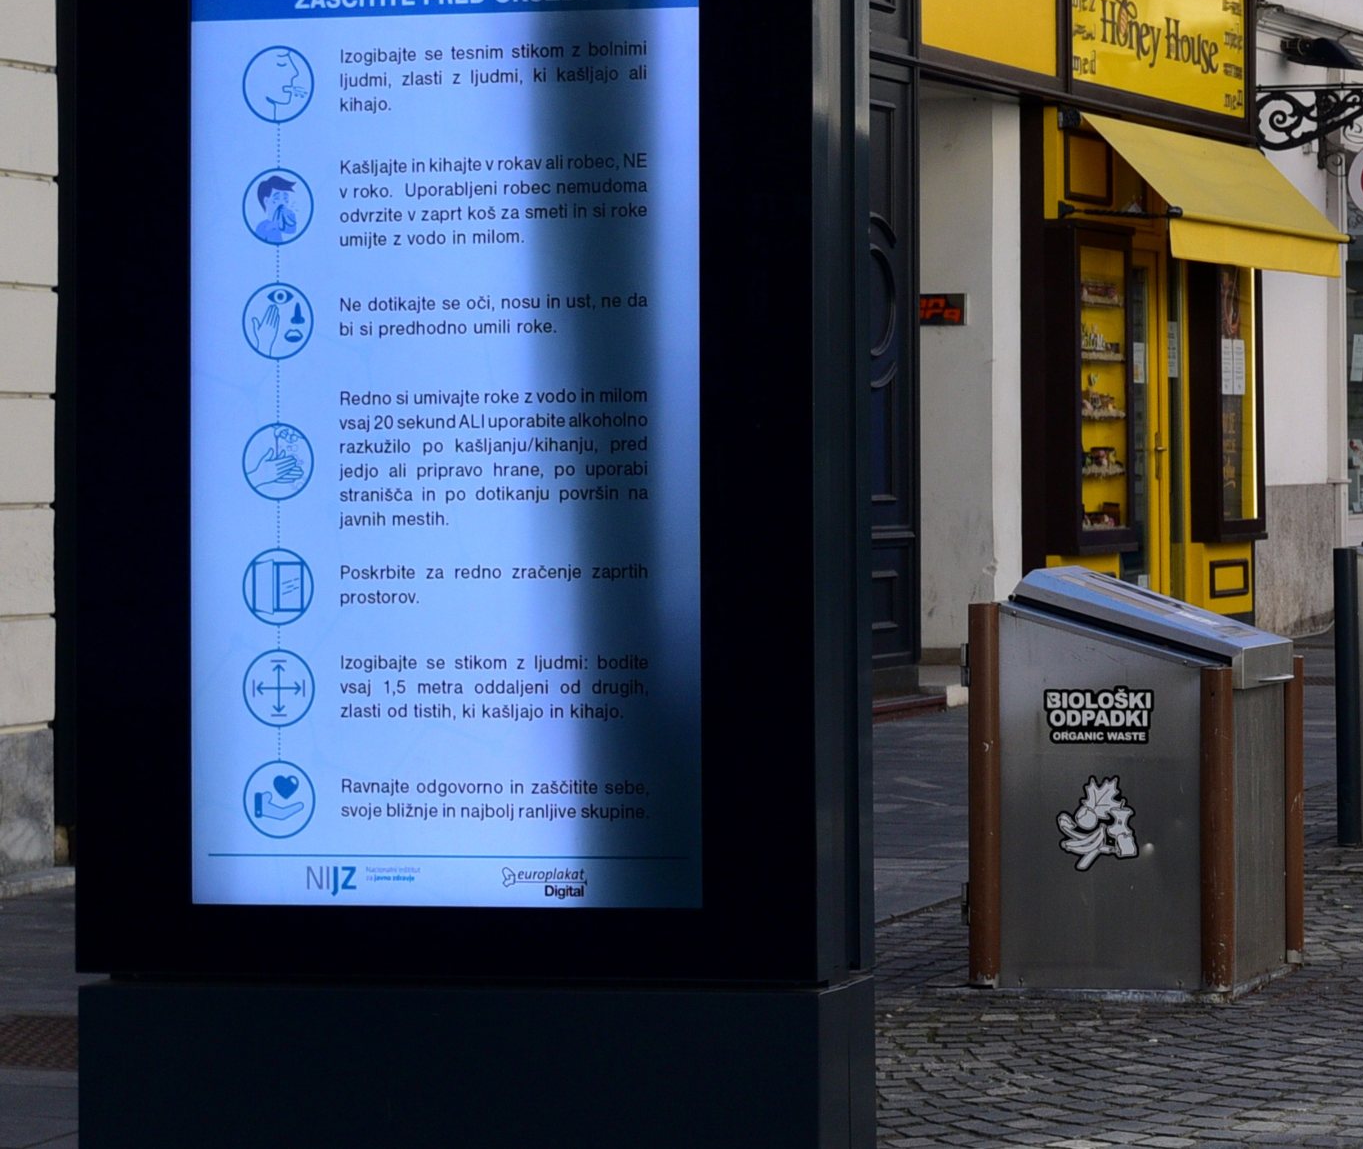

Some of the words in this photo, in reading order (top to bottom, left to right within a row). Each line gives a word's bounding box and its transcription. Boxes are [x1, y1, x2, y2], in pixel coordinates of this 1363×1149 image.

[340, 46, 417, 67] Izogibajte
[424, 49, 444, 62] se
[450, 44, 504, 61] tesnim
[511, 42, 564, 61] stikom
[570, 45, 581, 59] z
[588, 41, 649, 59] bolnimi
[1164, 17, 1219, 74] House
[339, 71, 392, 92] ljudmi,
[401, 69, 443, 87] zlasti
[451, 72, 462, 85] z
[470, 67, 524, 88] ljudmi,
[532, 66, 547, 83] ki
[556, 65, 619, 85] kašljajo
[627, 66, 649, 82] ali
[339, 95, 392, 115] kihajo.
[339, 158, 408, 178] Kašljajte
[411, 157, 426, 174] in
[429, 156, 483, 176] kihajte
[484, 159, 495, 172] v
[497, 155, 543, 172] rokav
[544, 153, 564, 171] ali
[567, 154, 620, 174] robec,
[622, 151, 648, 170] NE
[338, 187, 349, 200] v
[353, 183, 393, 199] roko.
[404, 180, 498, 201] Uporabljeni
[503, 179, 551, 196] robec
[555, 179, 649, 196] nemudoma
[339, 206, 403, 224] odvrzite
[406, 209, 417, 222] v
[420, 205, 463, 225] zaprt
[467, 205, 497, 221] koš
[500, 207, 521, 220] za
[524, 202, 569, 220] smeti
[573, 203, 587, 220] in
[593, 203, 607, 220] si
[611, 202, 648, 220] roke
[339, 231, 388, 250] umijte
[392, 233, 403, 247] z
[406, 229, 447, 246] vodo
[452, 229, 467, 246] in
[472, 228, 525, 245] milom.
[339, 296, 362, 313] Ne
[367, 295, 437, 315] dotikajte
[441, 298, 461, 311] se
[465, 294, 496, 313] oči,
[500, 297, 542, 310] nosu
[546, 293, 562, 310] in
[565, 294, 597, 314] ust,
[601, 297, 622, 310] ne
[627, 292, 649, 309] da
[339, 320, 354, 337] bi
[359, 320, 373, 337] si
[378, 319, 468, 340] predhodno
[473, 318, 511, 335] umili
[516, 317, 558, 335] roke.
[1046, 688, 1152, 709] BIOLOŠKI
[1050, 709, 1148, 727] ODPADKI
[1052, 731, 1104, 741] ORGANIC
[1106, 731, 1146, 741] WASTE
[341, 777, 410, 797] Ravnajte
[415, 778, 504, 798] odgovorno
[509, 778, 525, 795] in
[530, 777, 598, 795] zaščitite
[604, 779, 650, 798] sebe,
[340, 802, 383, 821] svoje
[386, 802, 439, 822] bližnje
[442, 802, 456, 819] in
[460, 802, 515, 822] najbolj
[518, 802, 577, 822] ranljive
[580, 803, 650, 823] skupine.
[306, 865, 357, 897] NIJZ
[517, 867, 585, 883] europlakat
[545, 884, 584, 899] Digital
